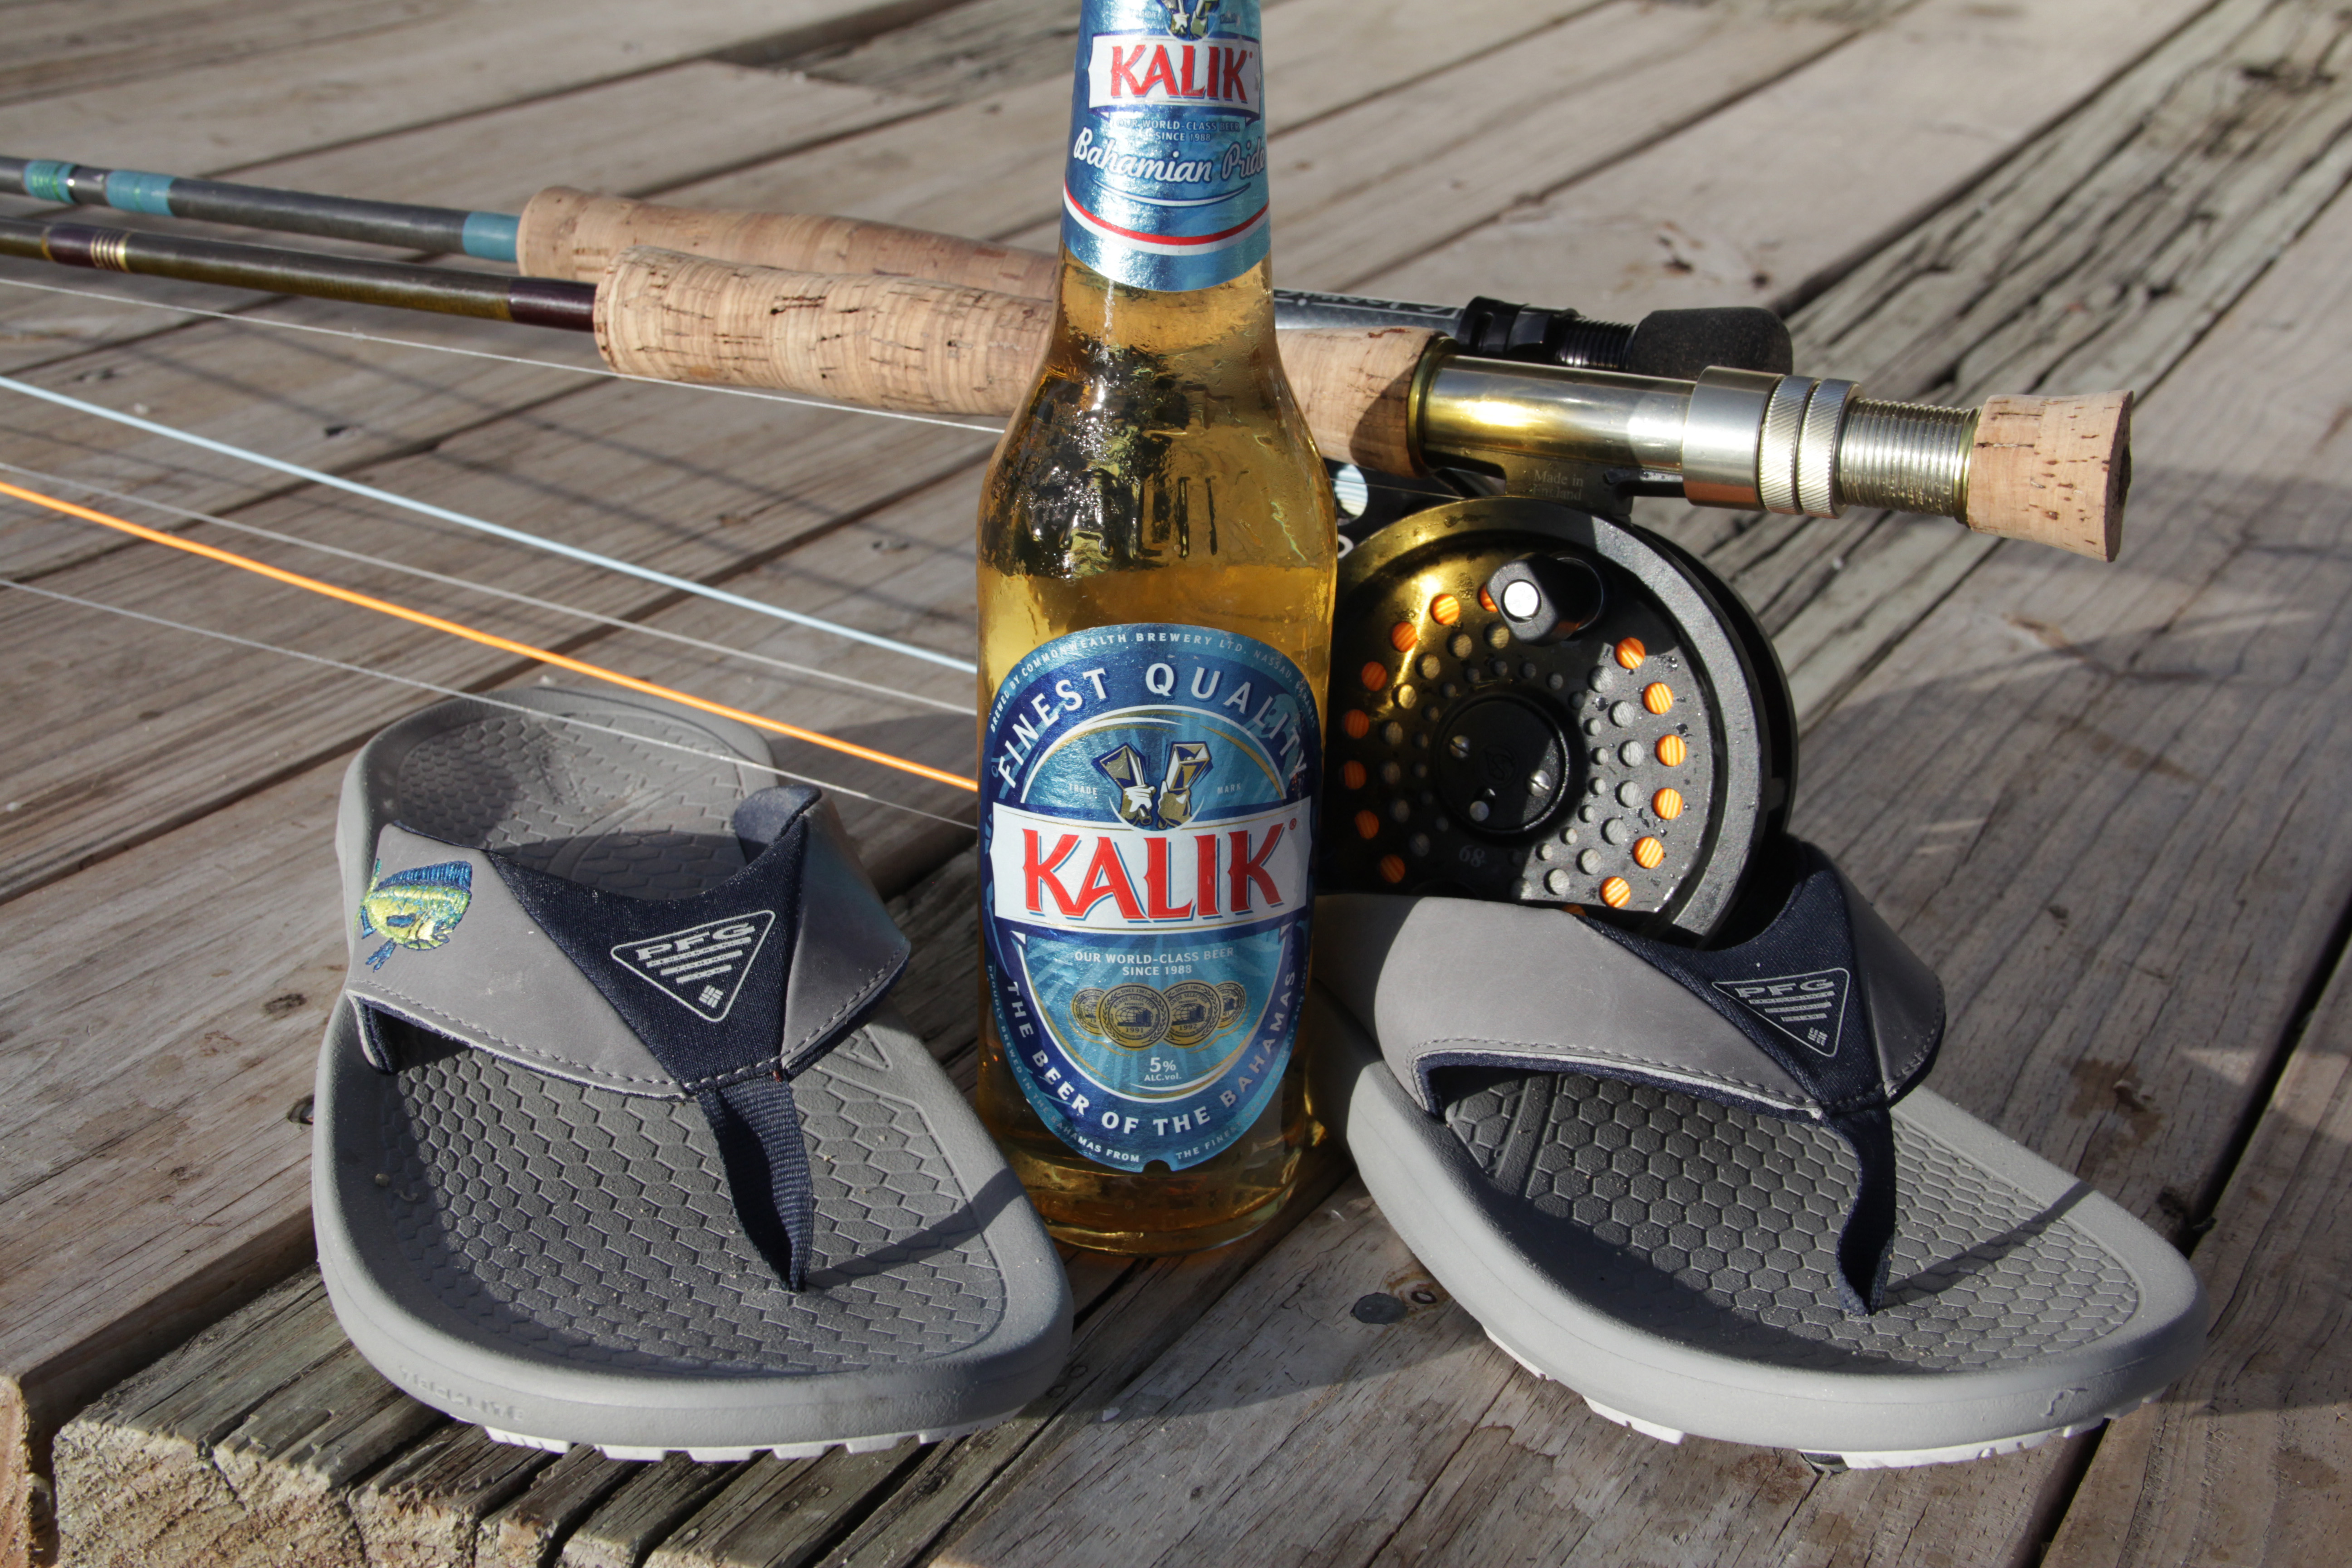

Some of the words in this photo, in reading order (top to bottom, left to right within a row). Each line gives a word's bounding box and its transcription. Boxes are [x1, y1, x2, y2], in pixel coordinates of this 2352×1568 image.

[1111, 44, 1248, 103] KALIK
[1117, 118, 1139, 127] OUR
[1142, 120, 1216, 131] WORLD-CLASS
[1219, 121, 1240, 132] BEER
[1155, 131, 1185, 141] SINCE
[1190, 133, 1211, 142] 1988
[1073, 127, 1213, 182] Bahamian
[1221, 137, 1265, 180] Pride
[1534, 469, 1568, 485] Made
[1573, 474, 1584, 487] in
[990, 690, 1010, 733] BREWED
[1009, 675, 1020, 690] BY
[1021, 634, 1127, 677] COMMONWEALTH
[1136, 632, 1212, 645] BREWERY
[998, 668, 1107, 789] FINEST
[1146, 662, 1307, 780] QUALITY
[1069, 783, 1097, 795] TRADE
[1217, 783, 1242, 794] MARK
[1022, 822, 1286, 923] KALIK
[636, 922, 756, 960] PFG
[1074, 951, 1101, 963] OUR
[1106, 951, 1199, 964] WORLD-CLASS
[1203, 947, 1234, 960] BEER
[1122, 966, 1160, 975] SINCE
[1164, 965, 1192, 975] 1988
[1735, 978, 1835, 997] PFG
[1113, 996, 1128, 1009] MONDE
[1130, 995, 1156, 1009] SELECTION
[1184, 994, 1209, 1004] SELECTION
[1007, 981, 1034, 1038] THE
[1032, 1049, 1089, 1115] BEER
[1102, 1111, 1139, 1134] OF
[1153, 1106, 1210, 1136] THE
[1219, 971, 1295, 1107] BAHAMAS
[988, 965, 1004, 1020] PROUDLY
[1001, 1025, 1023, 1073] BREWED
[1022, 1077, 1032, 1090] IN
[1033, 1093, 1049, 1113] THE
[1050, 1115, 1102, 1153] BAHAMAS
[1106, 1148, 1140, 1163] FROM
[1175, 1146, 1200, 1160] THE
